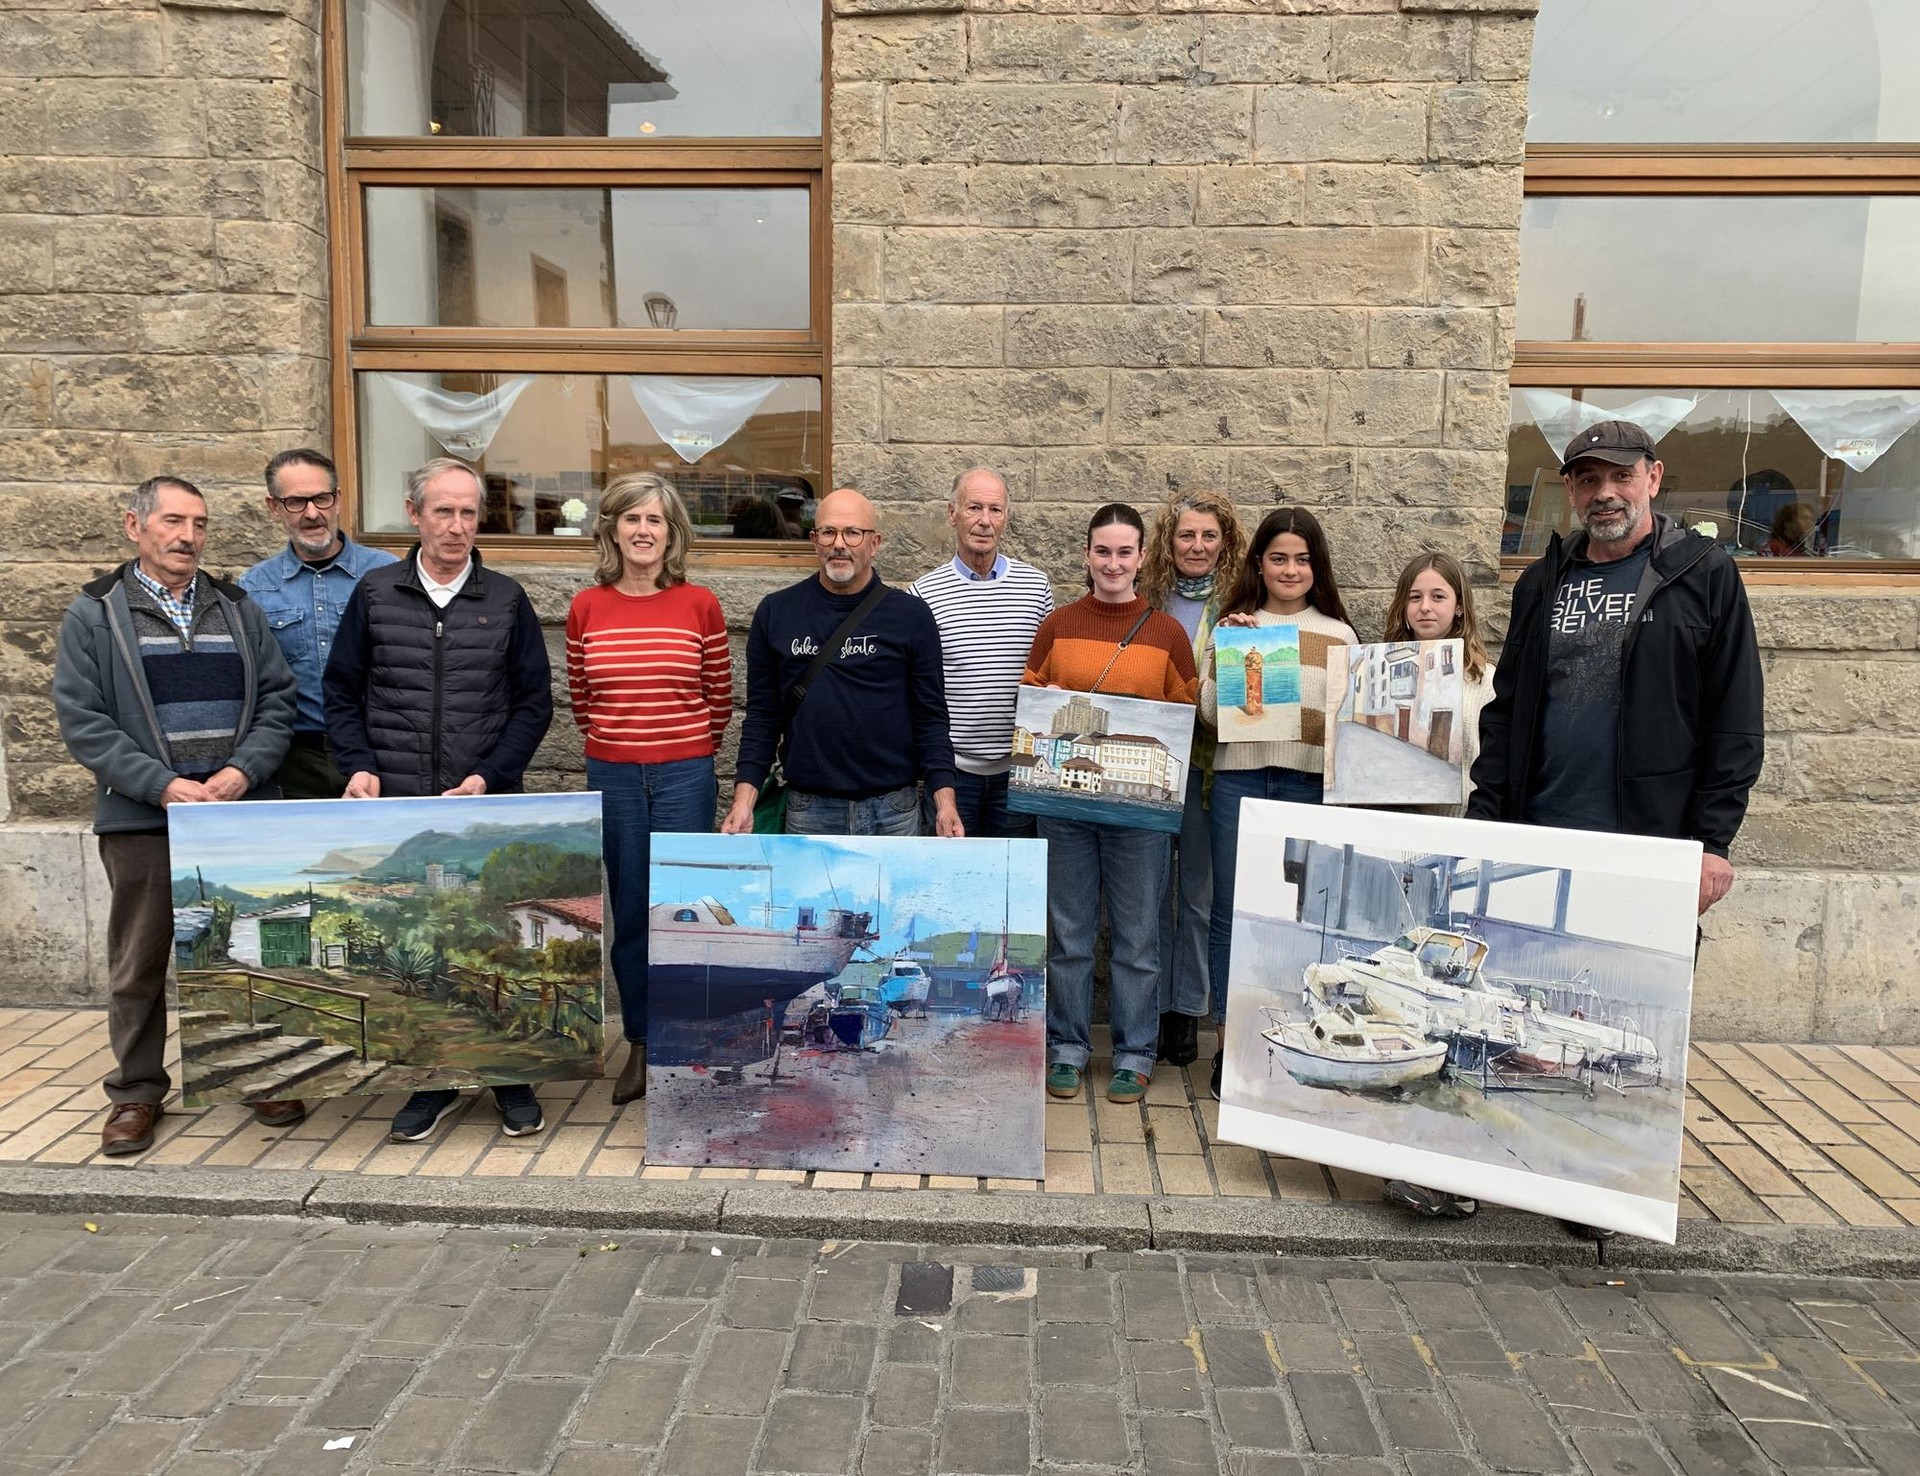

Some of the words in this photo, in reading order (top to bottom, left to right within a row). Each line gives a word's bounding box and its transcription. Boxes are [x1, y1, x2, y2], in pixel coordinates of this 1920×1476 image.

[1557, 578, 1604, 600] THE
[791, 636, 820, 656] bike
[840, 634, 878, 659] skate
